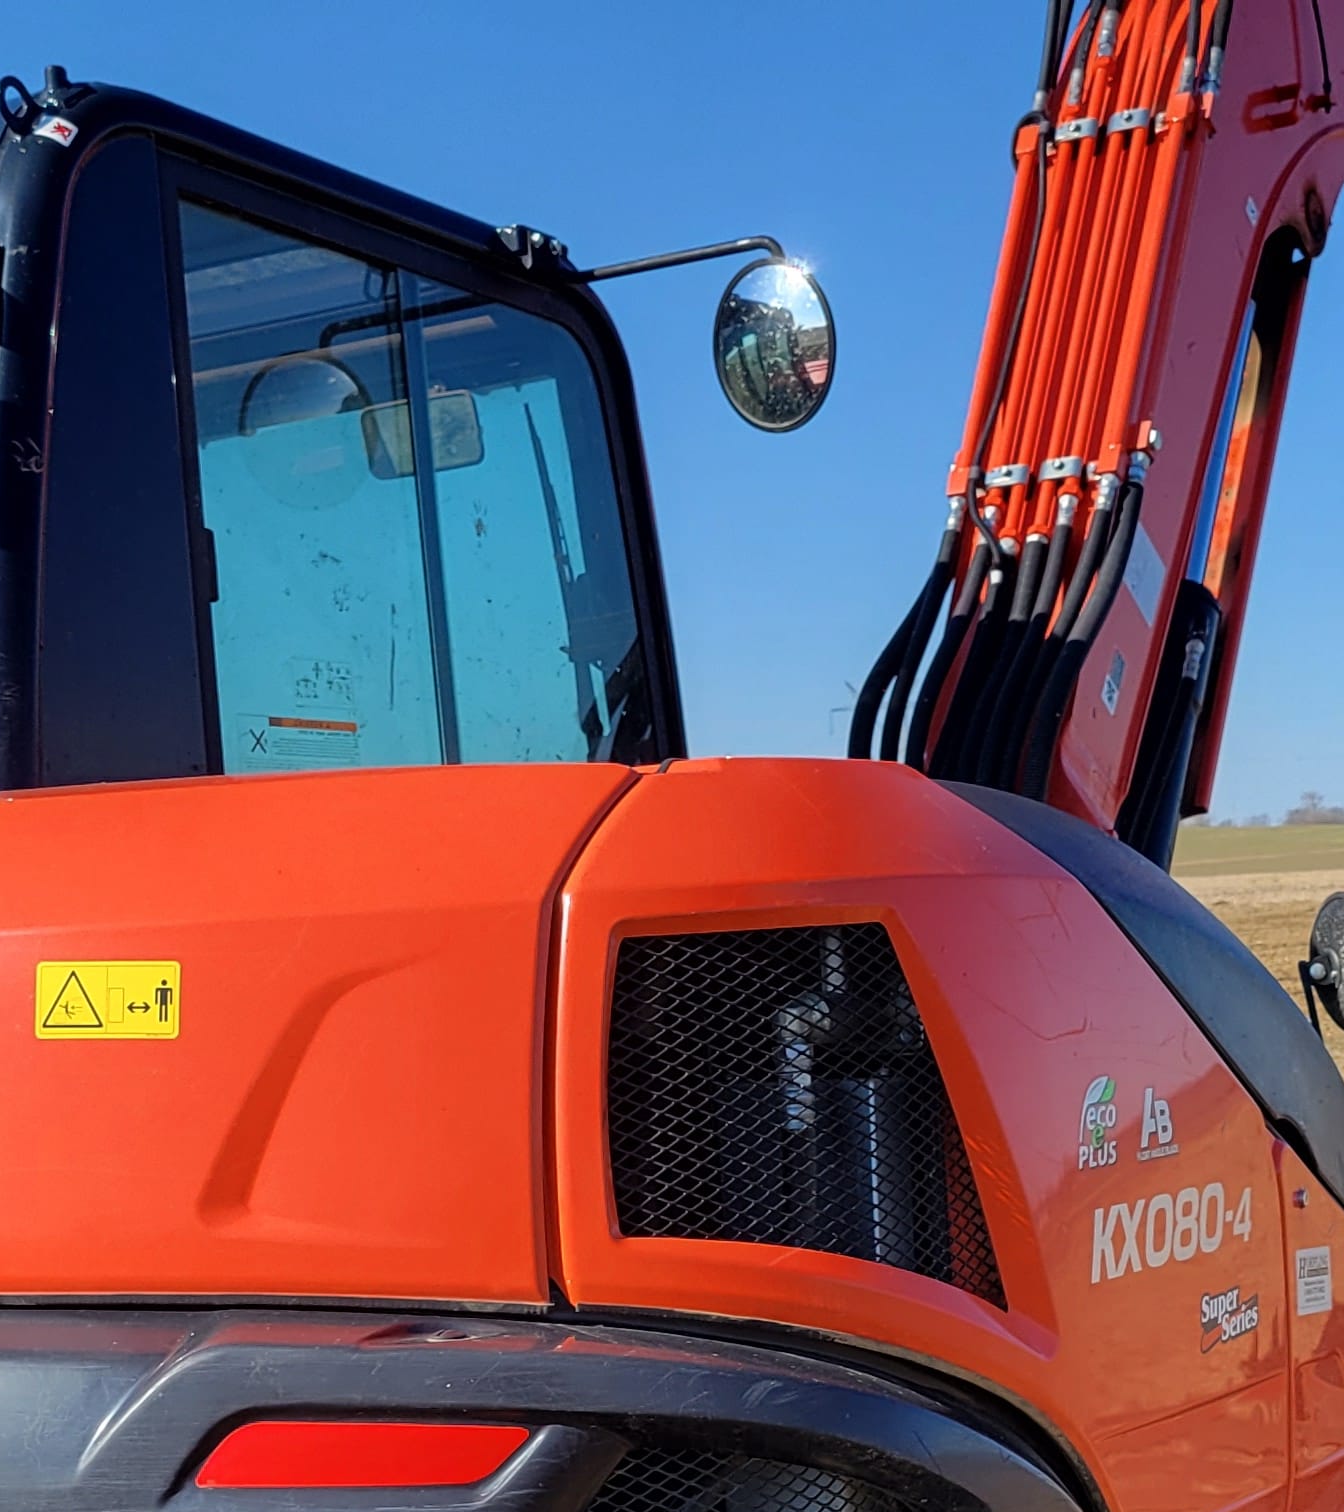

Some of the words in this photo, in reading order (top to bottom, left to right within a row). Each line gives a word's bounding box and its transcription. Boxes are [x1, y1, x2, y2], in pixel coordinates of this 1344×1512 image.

[1078, 1140, 1117, 1170] PLUS
[1090, 1181, 1253, 1285] KX080-4
[1200, 1287, 1240, 1324] Super
[1220, 1303, 1259, 1342] Series
